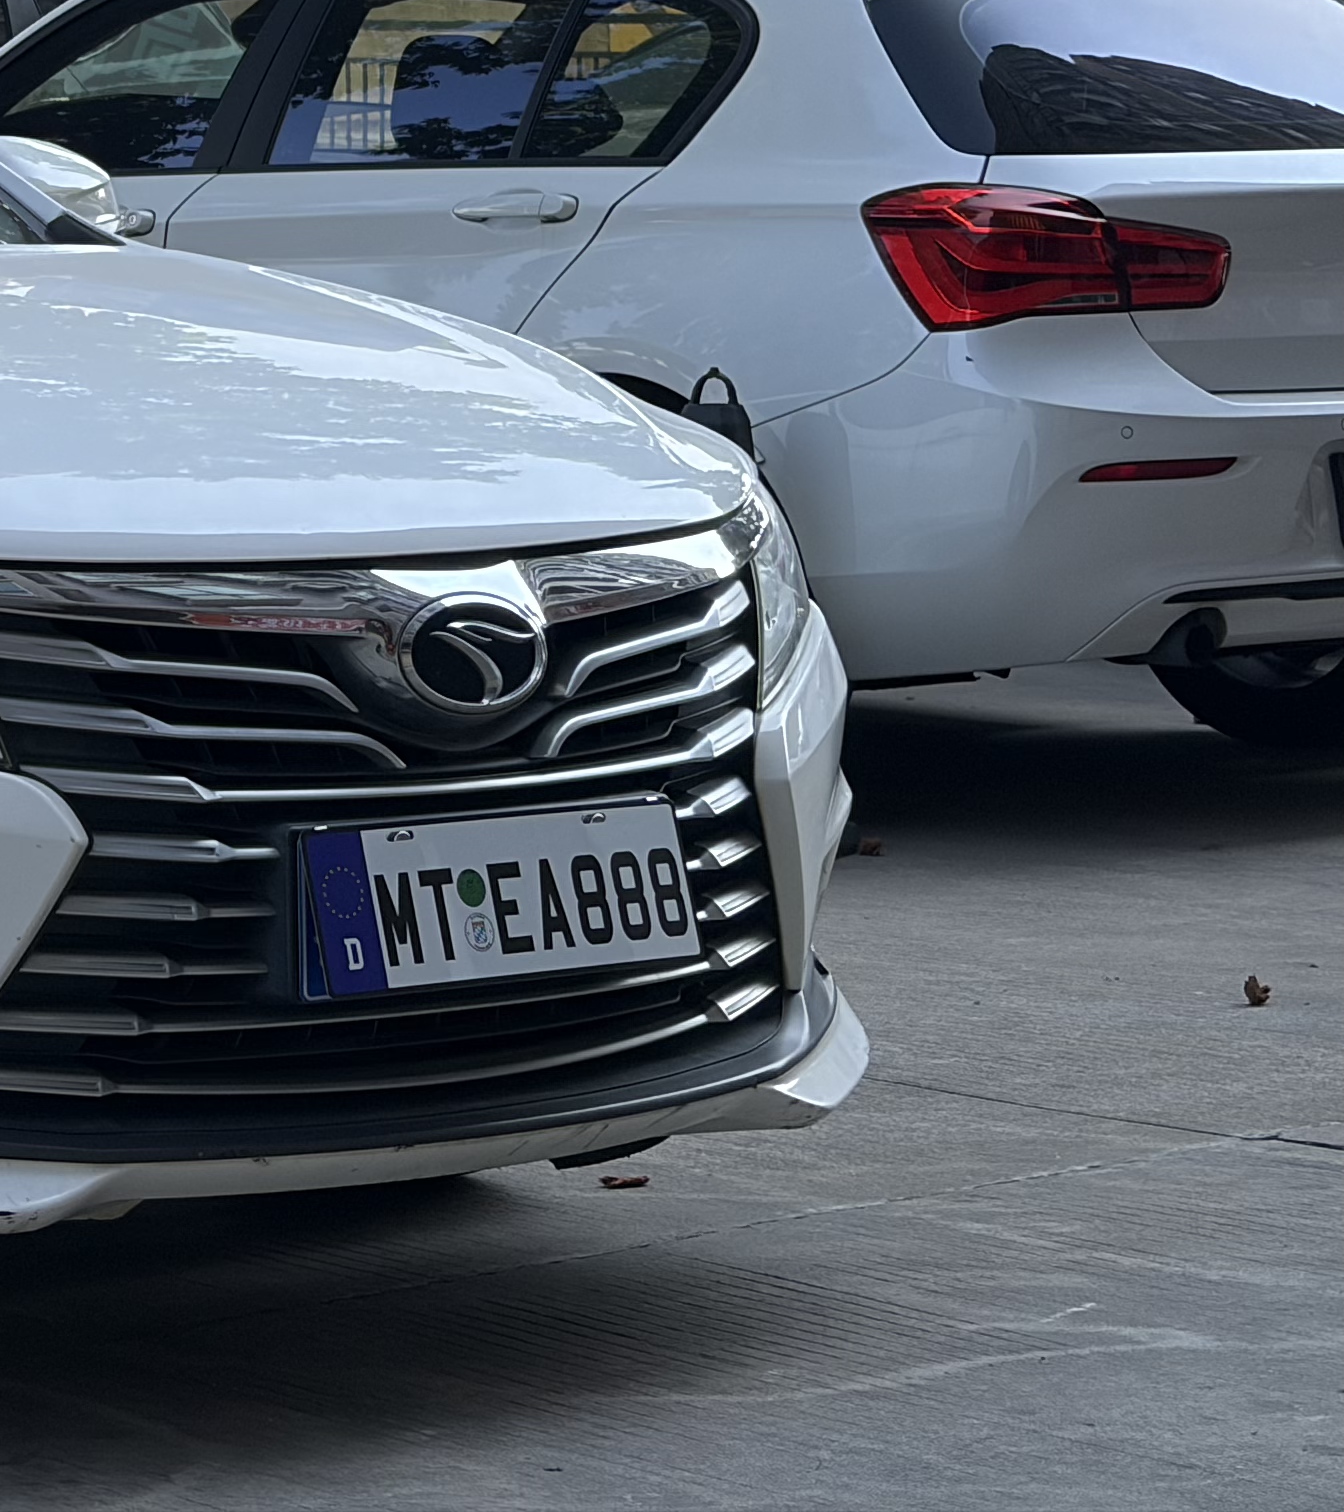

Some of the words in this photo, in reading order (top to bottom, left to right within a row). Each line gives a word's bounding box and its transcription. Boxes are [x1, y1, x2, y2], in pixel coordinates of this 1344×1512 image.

[374, 868, 457, 967] MT
[487, 848, 688, 955] EA888
[344, 937, 365, 971] D
